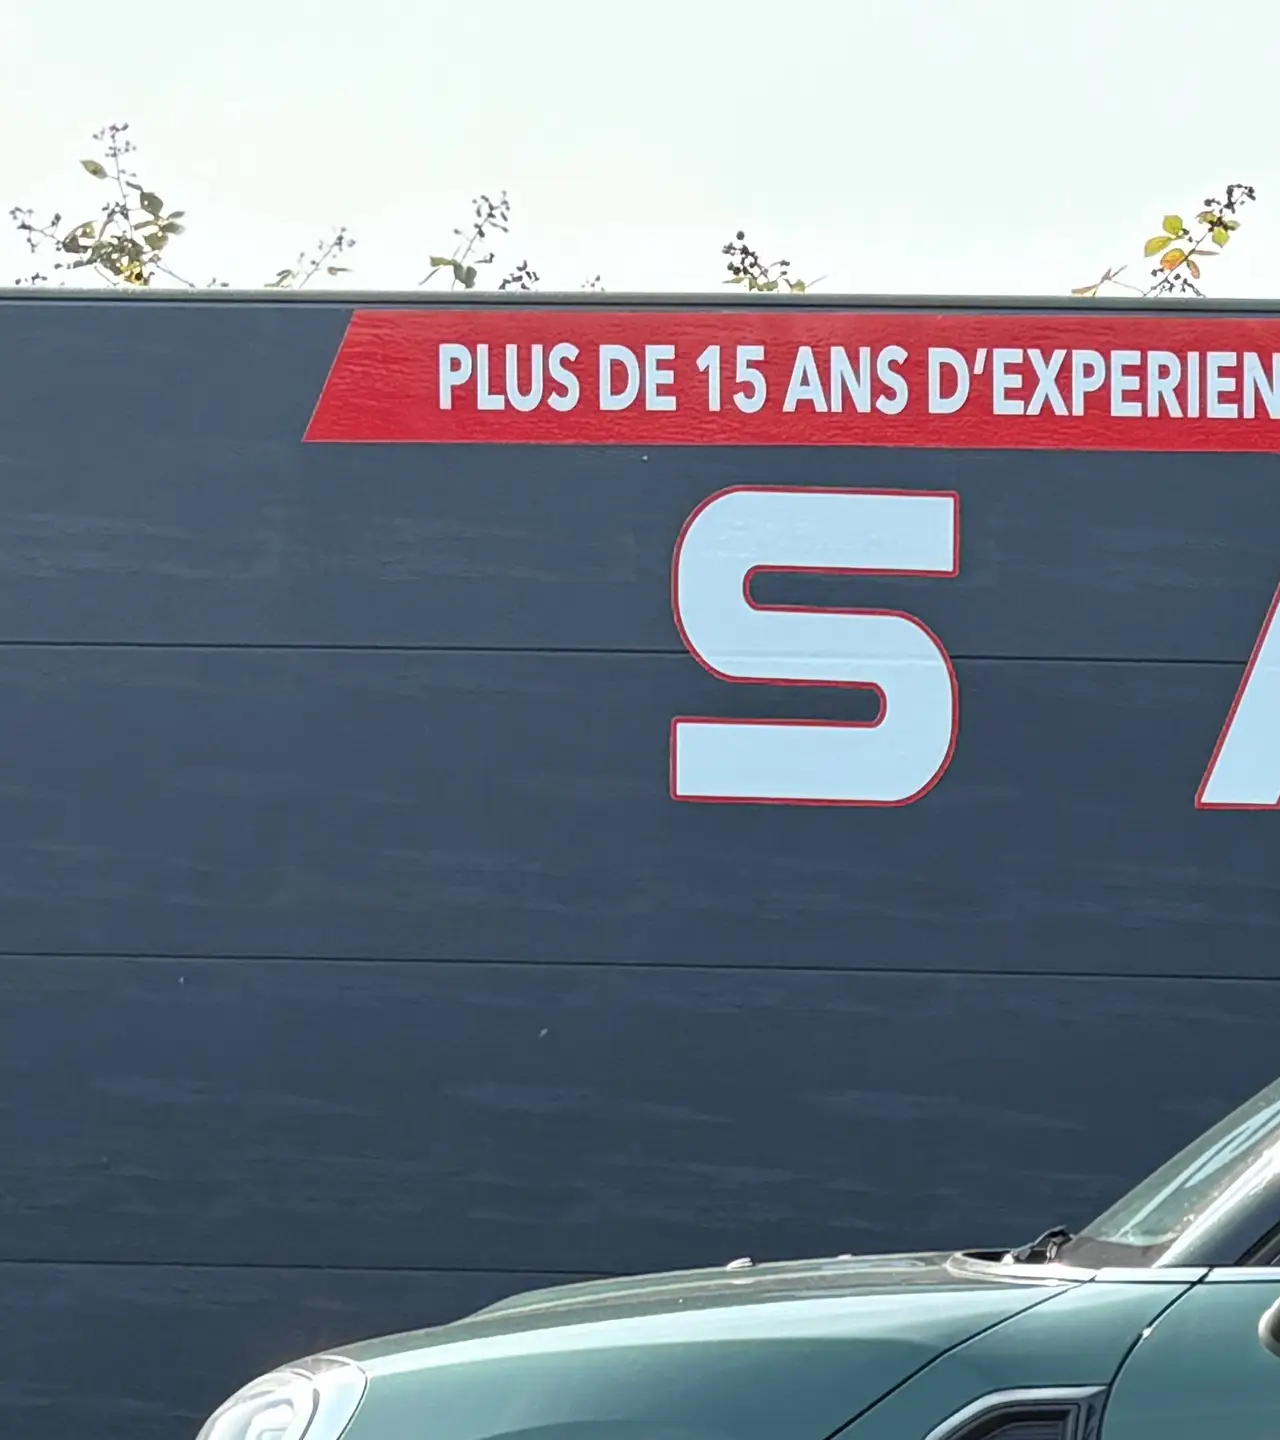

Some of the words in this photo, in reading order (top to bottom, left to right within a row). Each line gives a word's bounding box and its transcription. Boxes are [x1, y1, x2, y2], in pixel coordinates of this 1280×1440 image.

[437, 341, 581, 413] PLUS
[597, 343, 678, 413] DE
[695, 343, 767, 414] 15
[781, 344, 910, 416] ANS
